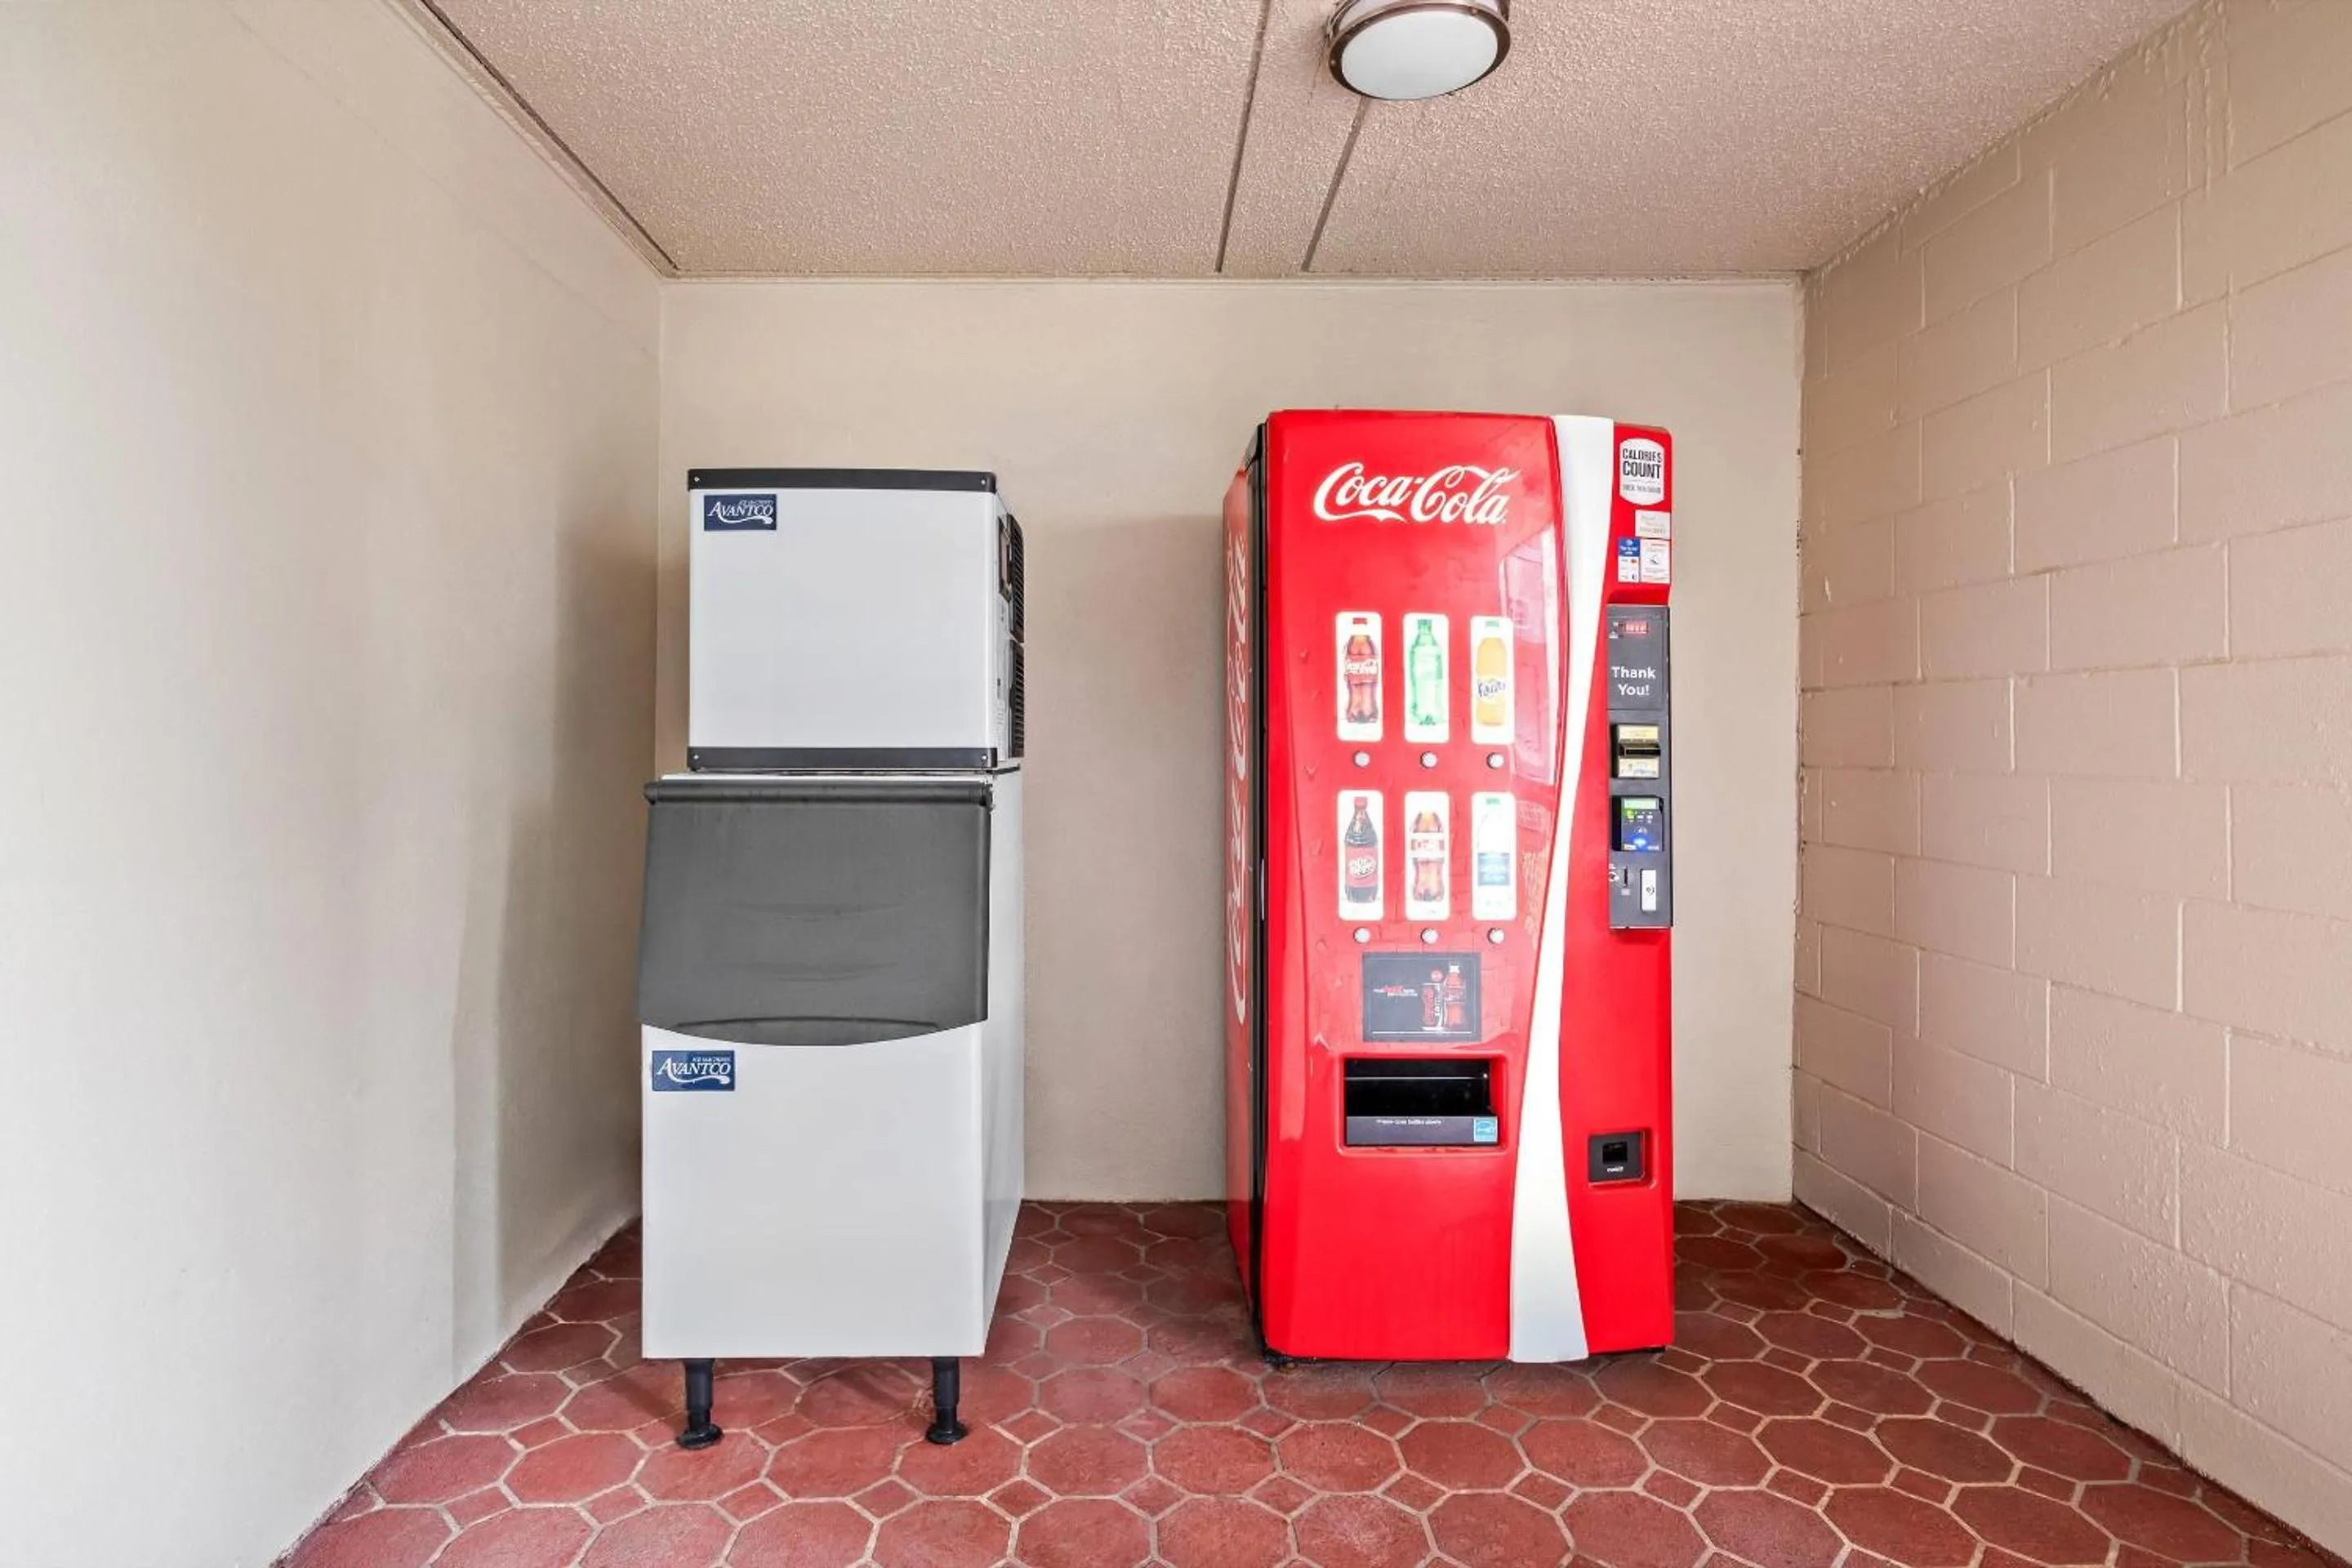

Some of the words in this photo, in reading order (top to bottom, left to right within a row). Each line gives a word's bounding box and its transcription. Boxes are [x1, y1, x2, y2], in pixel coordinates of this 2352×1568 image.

[1623, 448, 1663, 463] CALORIES
[1623, 461, 1662, 479] COUNT
[1312, 461, 1521, 524] Coca-Cola
[1611, 666, 1656, 679] Thank
[1618, 684, 1650, 696] You!
